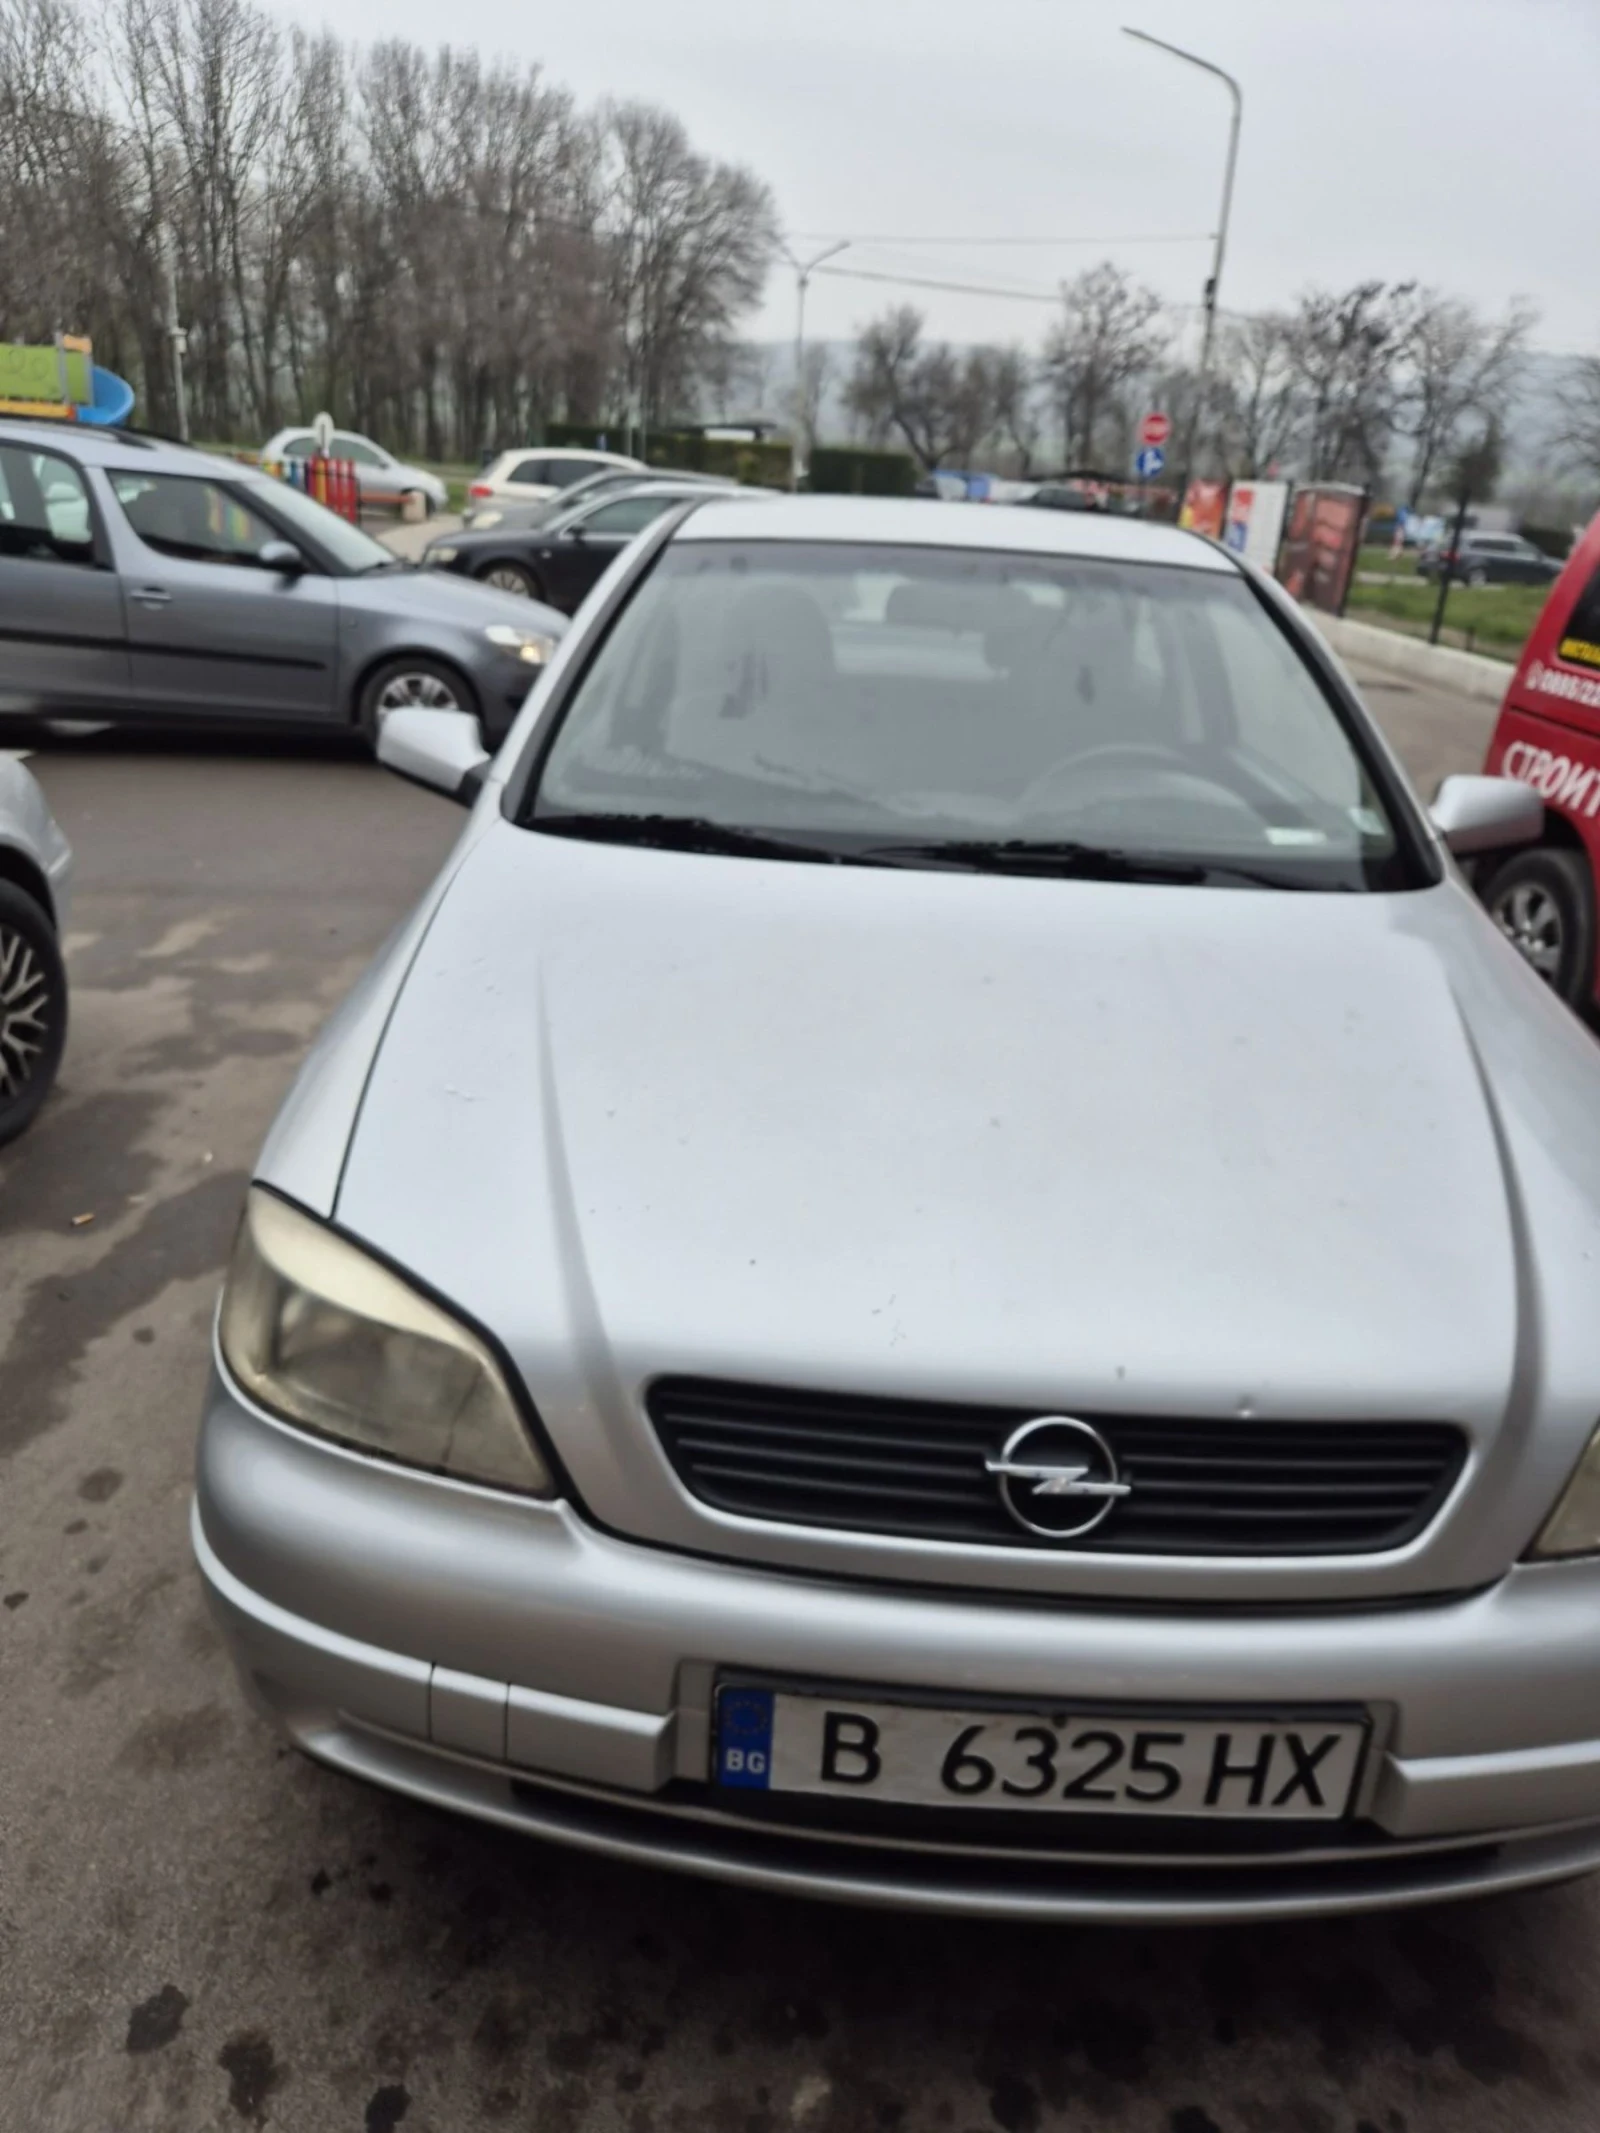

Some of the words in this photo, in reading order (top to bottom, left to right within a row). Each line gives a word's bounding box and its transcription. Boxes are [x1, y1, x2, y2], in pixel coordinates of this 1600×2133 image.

[725, 1747, 766, 1774] BG
[821, 1709, 882, 1785] B
[940, 1724, 1185, 1803] 6325
[1204, 1732, 1341, 1807] HX
